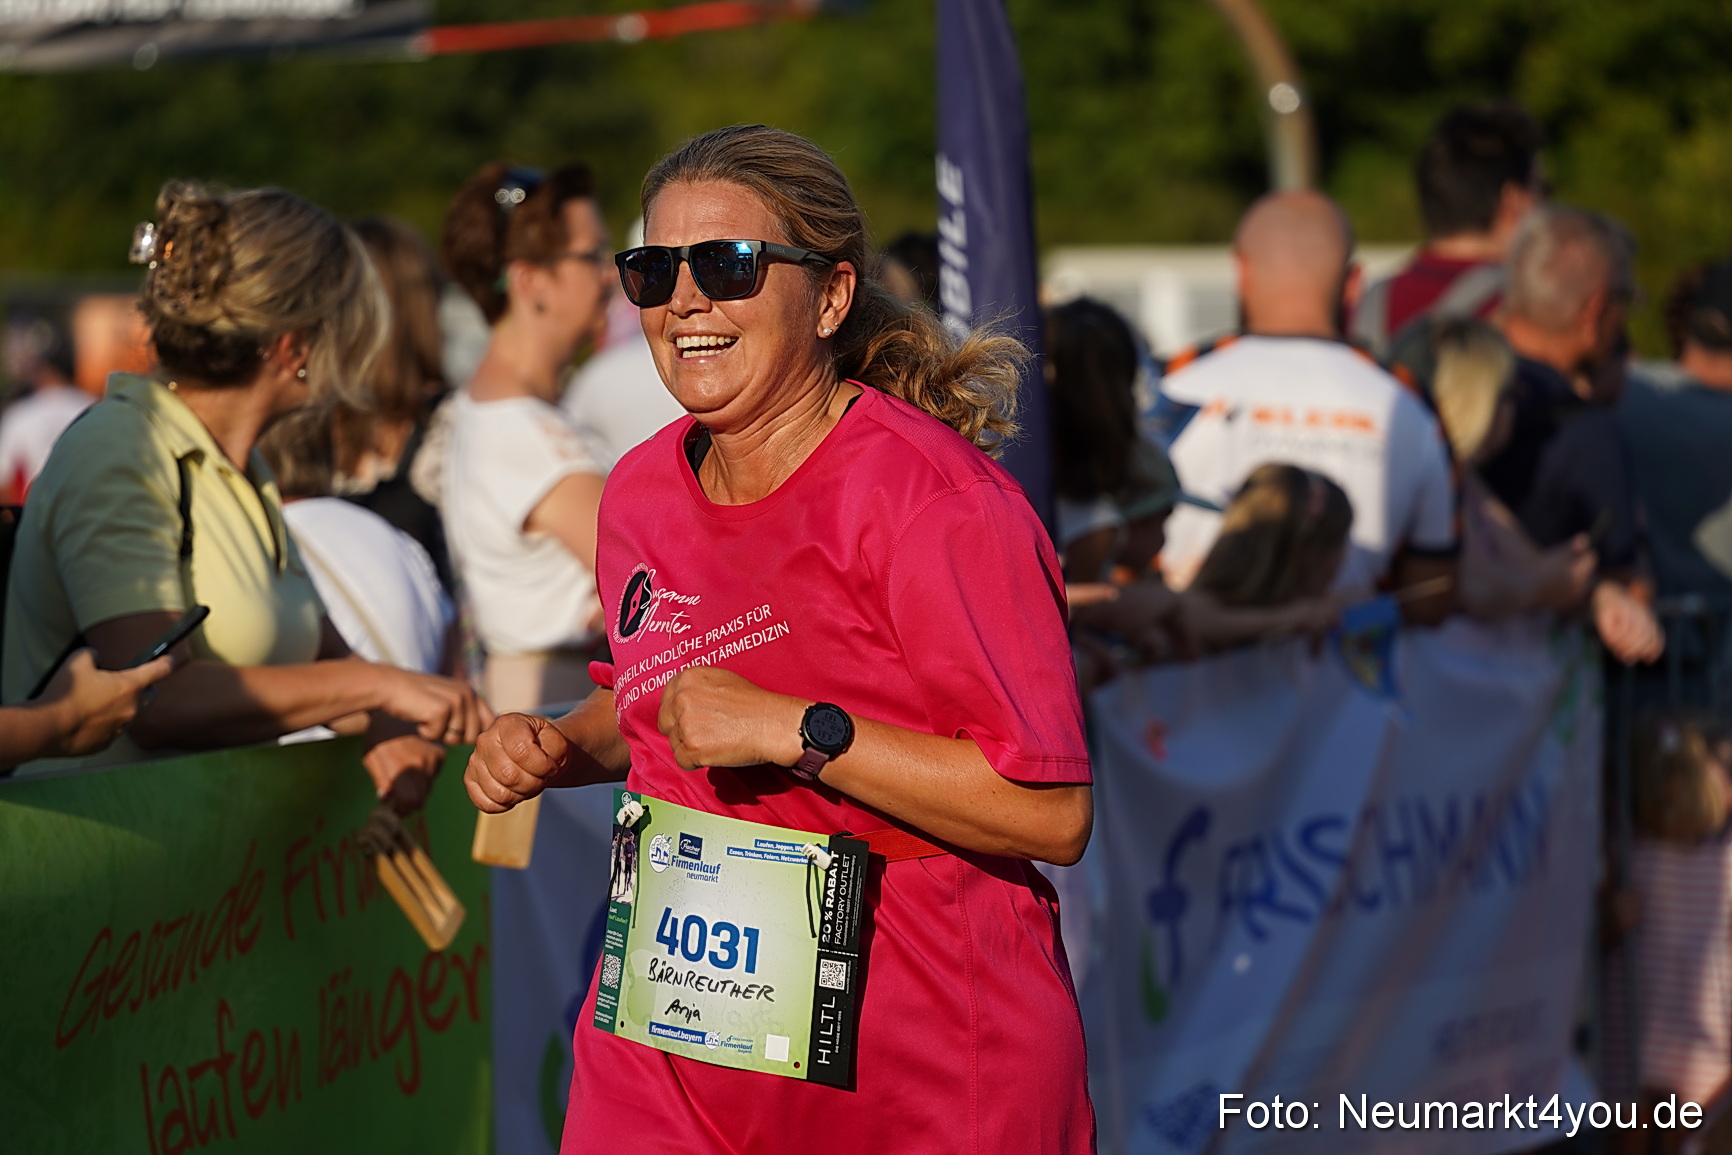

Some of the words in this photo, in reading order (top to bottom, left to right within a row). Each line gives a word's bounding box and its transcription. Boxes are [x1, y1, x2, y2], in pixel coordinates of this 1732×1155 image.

[705, 615, 745, 646] PRAXIS
[746, 604, 772, 626] FÜR
[622, 686, 640, 710] UND
[671, 855, 721, 874] Firmenlauf
[780, 855, 809, 864] Netzwerke
[686, 872, 719, 883] neumarkt
[839, 853, 851, 896] OUTLET
[824, 910, 834, 921] %
[834, 896, 847, 945] FACTORY
[55, 838, 265, 1050] Gesunde
[655, 906, 760, 974] 4031
[822, 923, 832, 943] 20
[648, 957, 775, 1002] BÄRNREUTHER
[664, 998, 701, 1024] Anja
[651, 1024, 703, 1043] firmenlauf.bayern
[817, 996, 836, 1065] HILTL
[720, 1040, 753, 1050] Firmenlauf
[140, 999, 303, 1155] laufen
